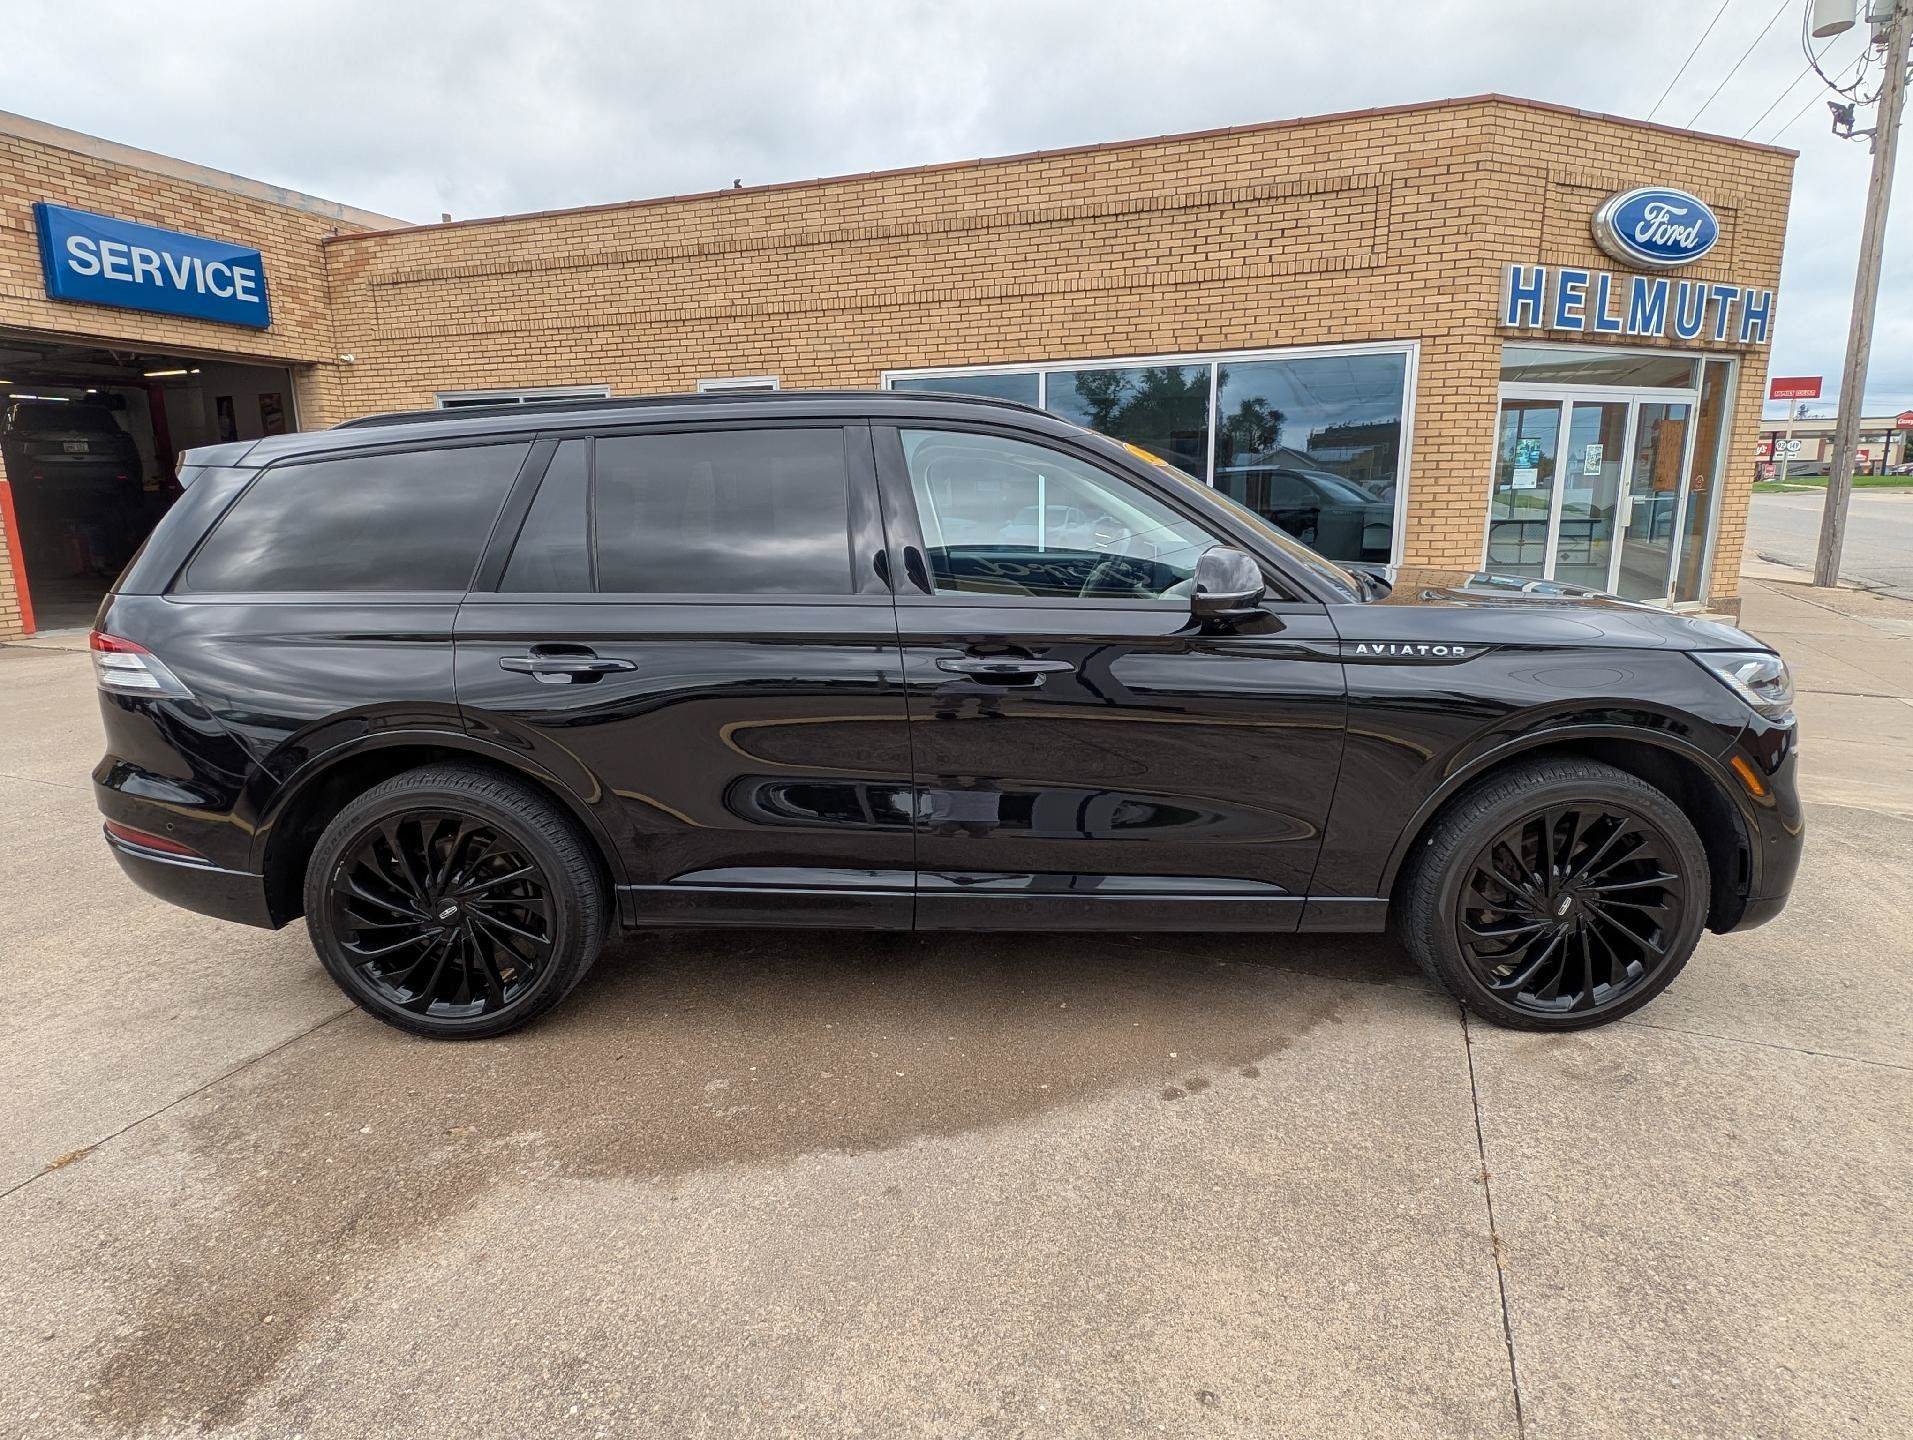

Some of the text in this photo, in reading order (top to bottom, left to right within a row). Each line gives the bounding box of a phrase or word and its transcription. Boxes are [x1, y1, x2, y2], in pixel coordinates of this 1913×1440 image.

[1634, 202, 1702, 248] Ford
[66, 235, 259, 303] SERVICE
[1506, 264, 1772, 344] HELMUTH
[1356, 643, 1466, 656] AVIATOR
